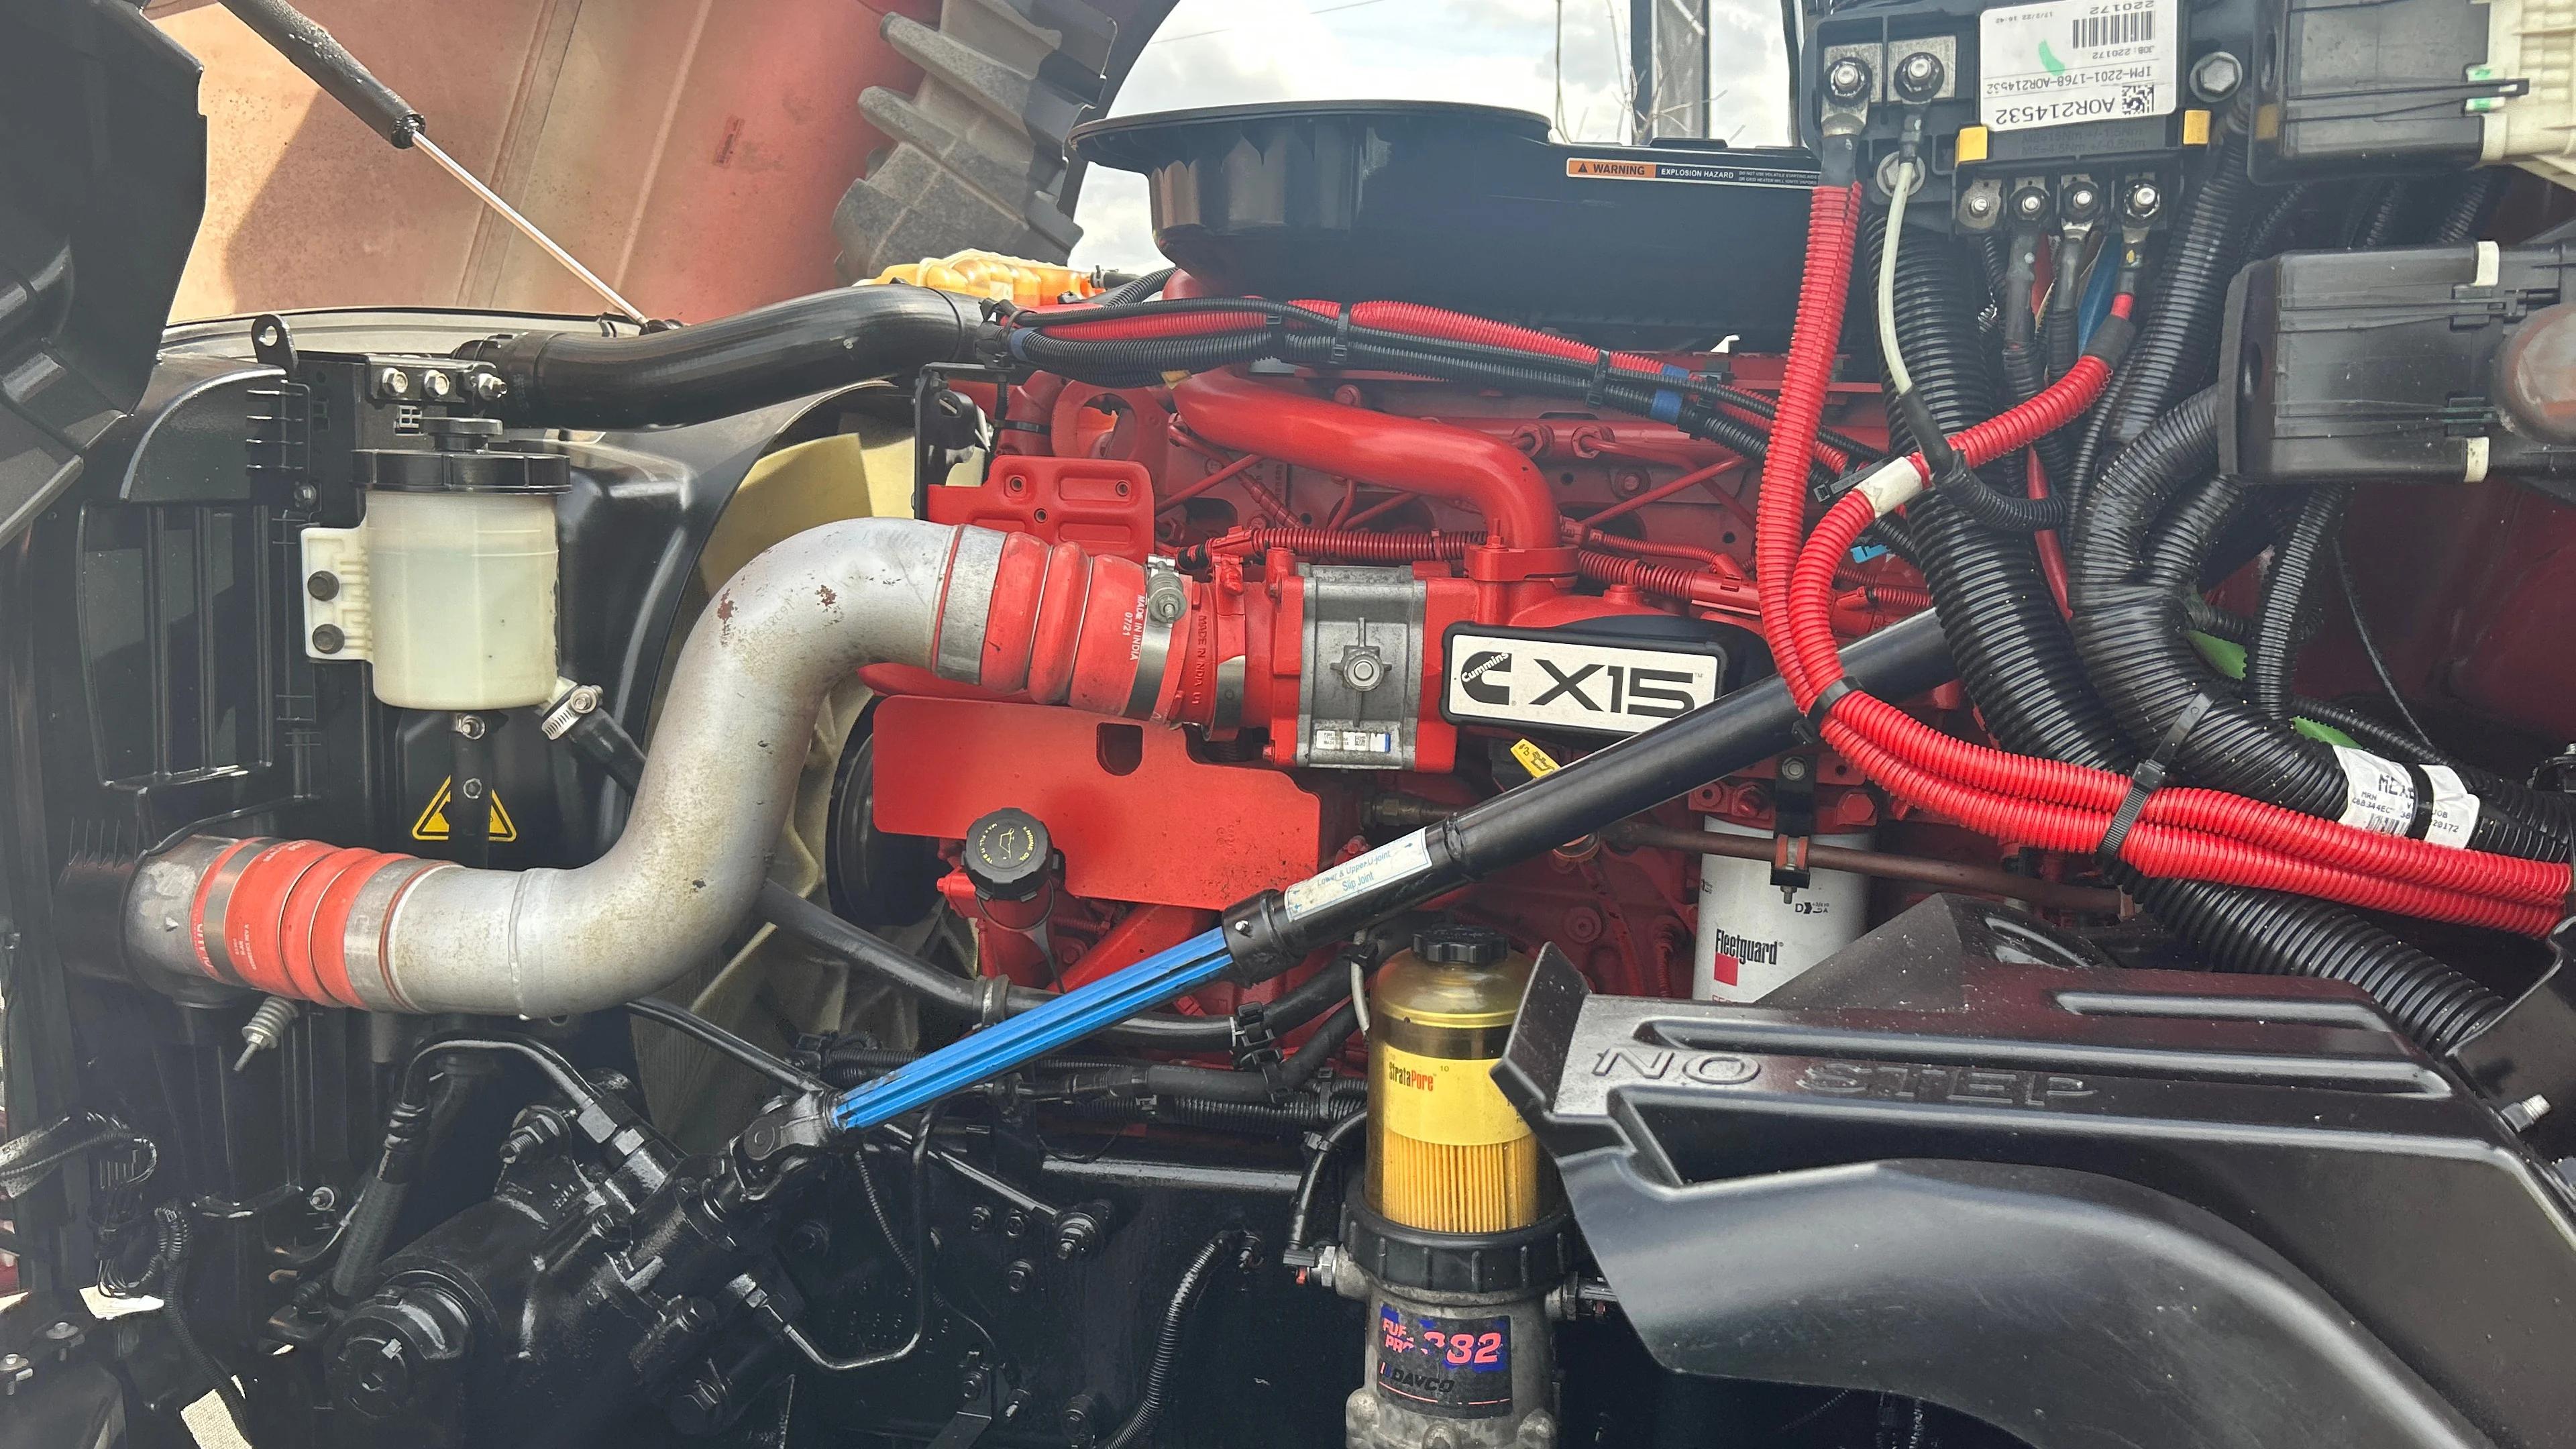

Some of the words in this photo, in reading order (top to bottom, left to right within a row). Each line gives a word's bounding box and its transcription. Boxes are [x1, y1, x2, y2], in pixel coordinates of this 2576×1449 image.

[2090, 0, 2155, 14] 220172
[1593, 163, 1645, 176] WARNING
[1661, 168, 1702, 178] EXPLOSION
[1704, 170, 1734, 179] HAZARD
[1135, 594, 1145, 621] MADE
[1122, 611, 1133, 637] 07/21
[1134, 622, 1142, 633] IN
[1130, 634, 1141, 661] INDIA
[1461, 651, 1509, 683] Cummins
[1528, 658, 1695, 718] X15
[2432, 808, 2448, 818] JOB
[1022, 826, 1034, 851] ENGINE
[1317, 874, 1338, 887] Lower
[1346, 861, 1367, 875] Upper
[1342, 878, 1356, 892] Slip
[1357, 872, 1375, 886] Joint
[1715, 928, 1778, 965] Fleetguard
[1389, 1061, 1434, 1092] StrataPore
[1591, 1047, 1762, 1085] NO
[1796, 1063, 2098, 1107] STEP
[1392, 1368, 1455, 1393] DAVCO
